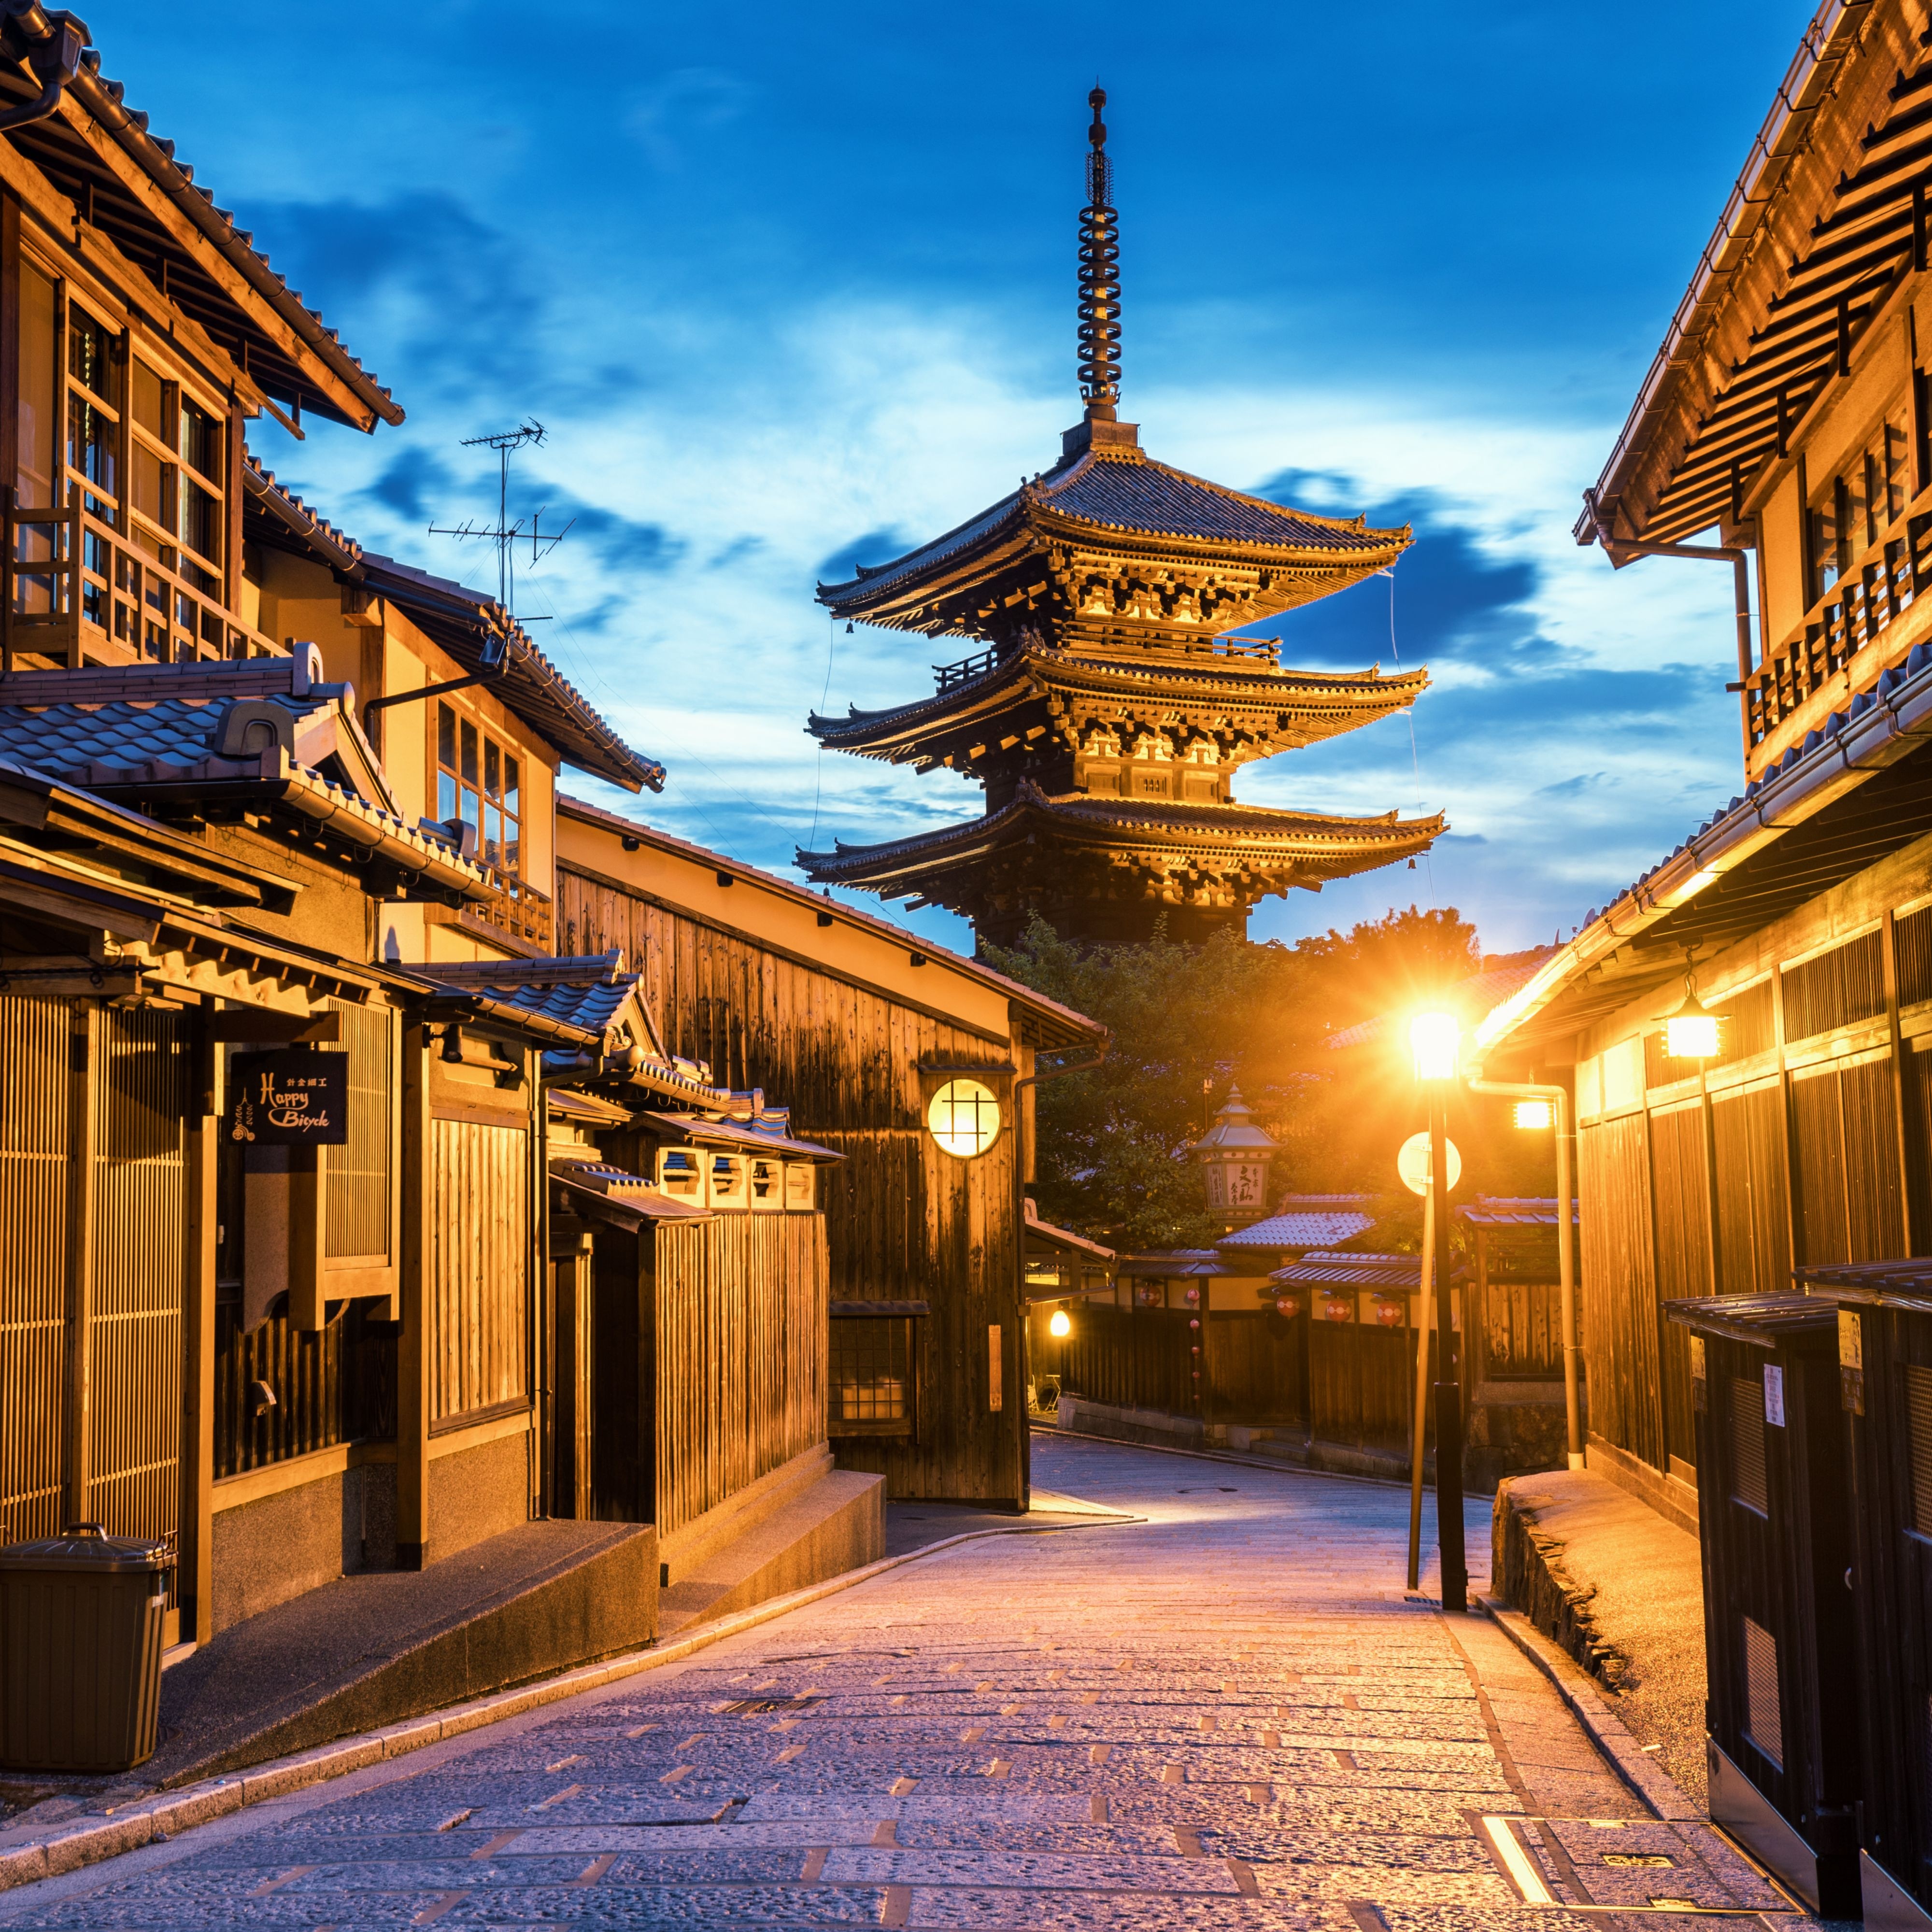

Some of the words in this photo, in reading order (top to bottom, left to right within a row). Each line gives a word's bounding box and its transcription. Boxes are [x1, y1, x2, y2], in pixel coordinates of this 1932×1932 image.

[260, 1072, 309, 1110] Happy
[286, 1078, 327, 1087] 針金細工
[269, 1108, 330, 1132] Bicycle
[1239, 1165, 1253, 1202] 文の助
